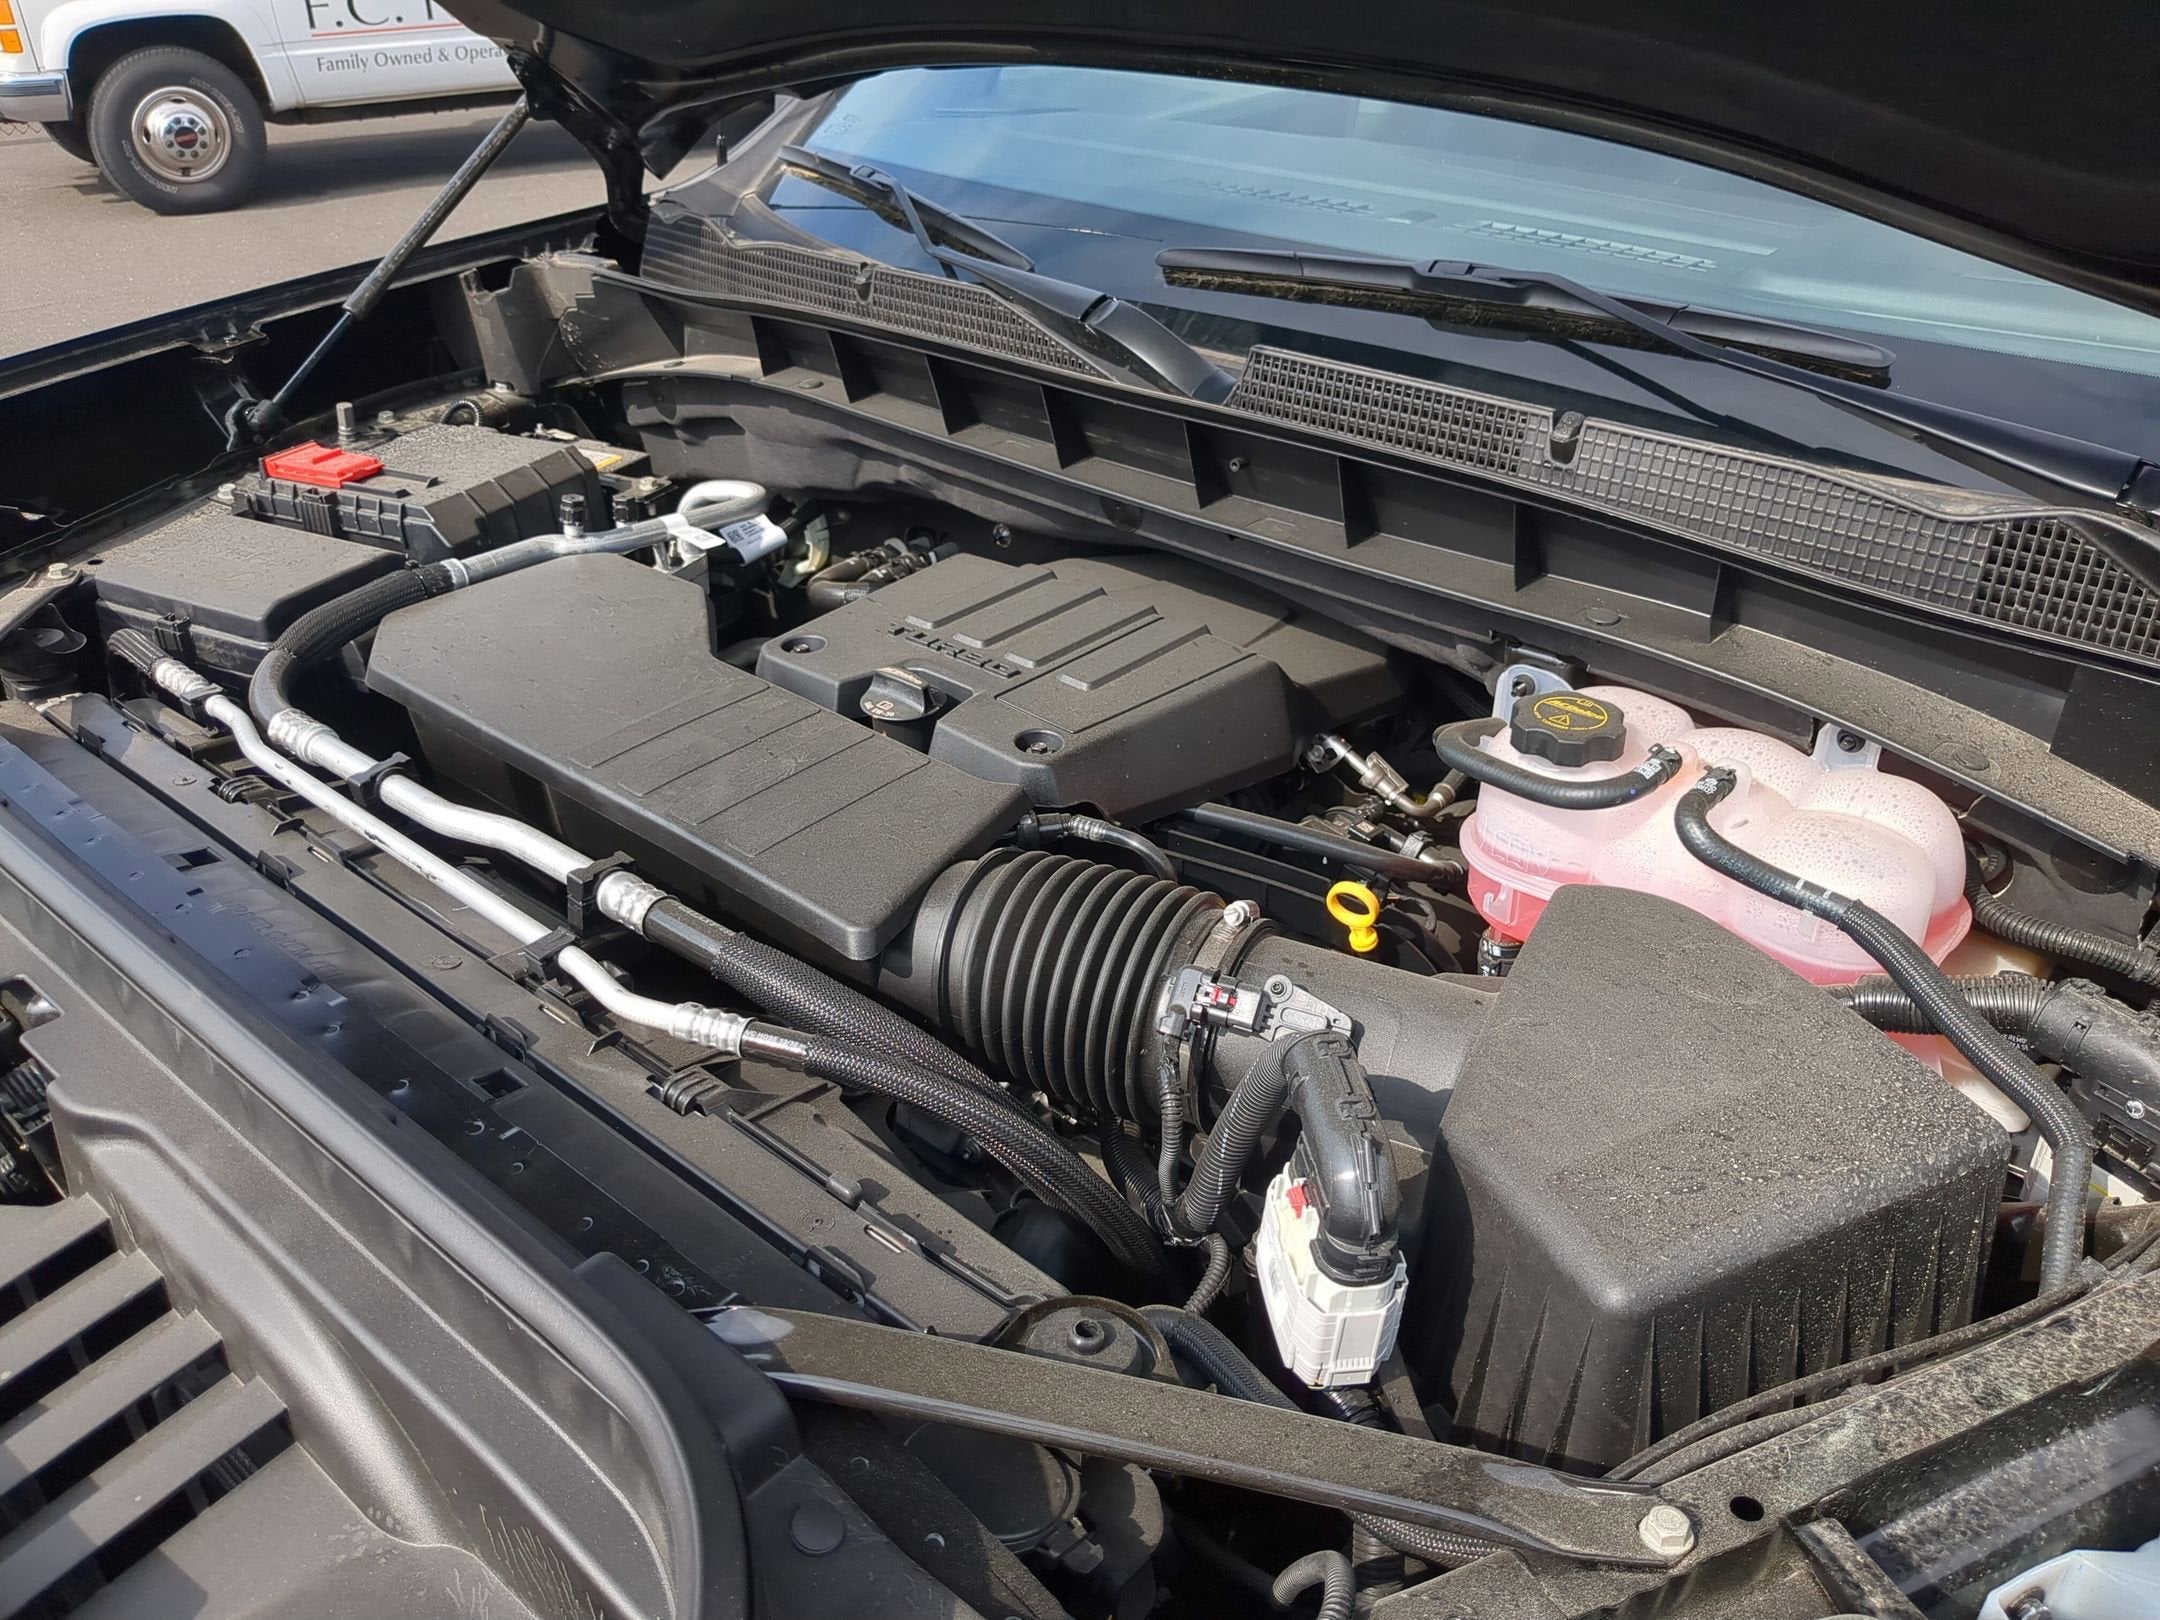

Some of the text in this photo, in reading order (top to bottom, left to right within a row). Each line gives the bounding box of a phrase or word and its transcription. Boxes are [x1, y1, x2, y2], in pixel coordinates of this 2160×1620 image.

[316, 45, 506, 73] Family Owned & Opera
[887, 622, 1021, 680] TURBO
